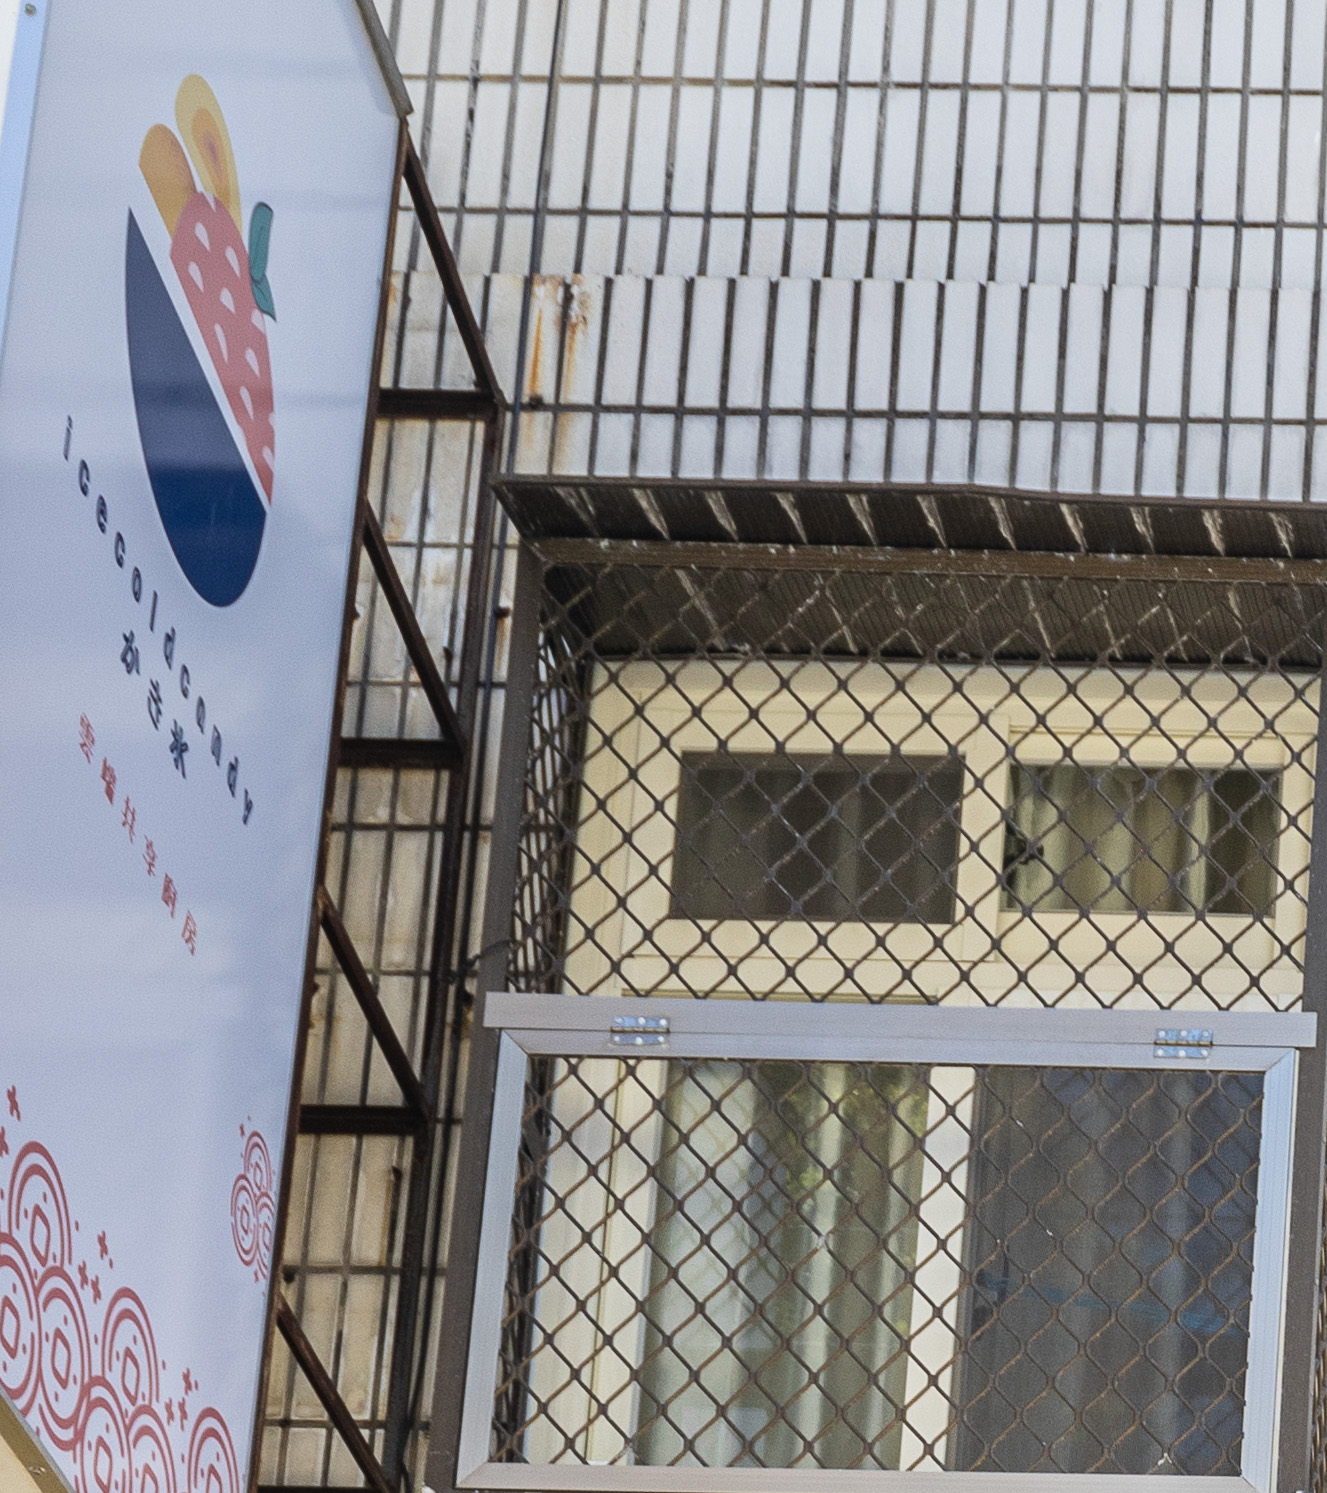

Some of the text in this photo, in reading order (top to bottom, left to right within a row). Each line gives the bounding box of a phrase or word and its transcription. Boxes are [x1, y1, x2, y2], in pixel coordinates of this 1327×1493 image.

[64, 416, 253, 825] icecoldcandy
[121, 630, 188, 779] かき氷
